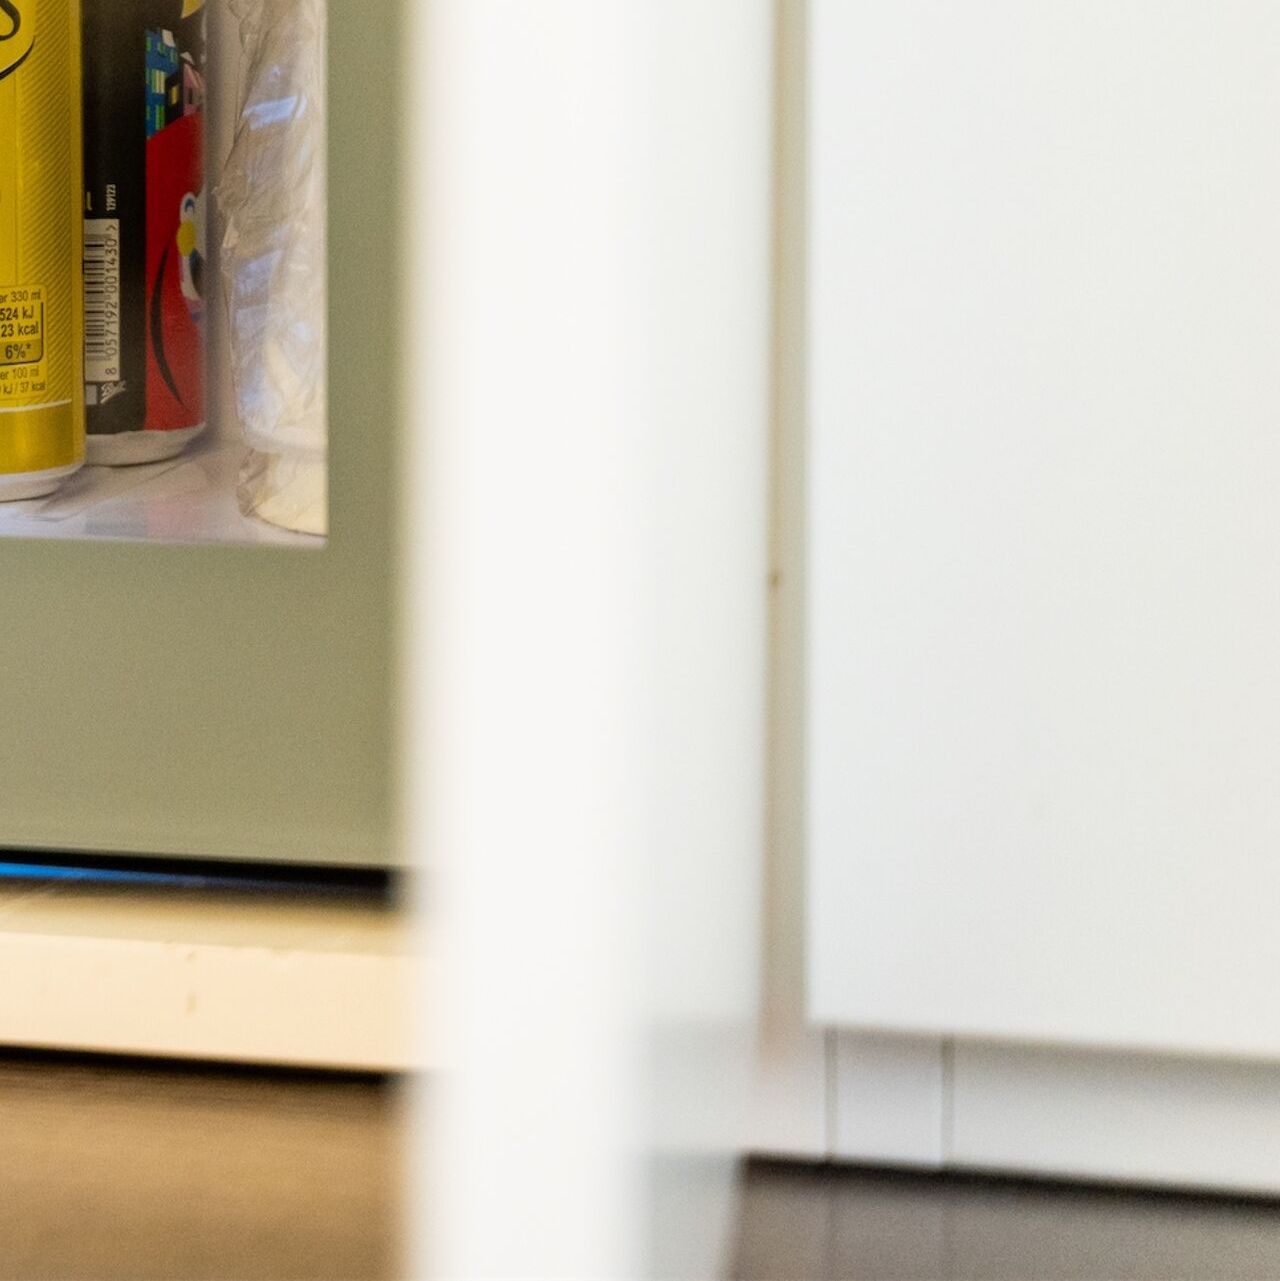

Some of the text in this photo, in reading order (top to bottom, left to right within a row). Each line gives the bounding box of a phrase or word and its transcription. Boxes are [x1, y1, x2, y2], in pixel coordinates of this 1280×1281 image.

[105, 238, 117, 293] 001430
[10, 289, 29, 303] 330
[31, 288, 41, 301] ml
[0, 306, 34, 322] 524 kJ
[17, 320, 39, 336] kcal
[105, 301, 117, 355] 057192
[12, 367, 28, 380] 100
[105, 368, 117, 376] 8
[3, 382, 13, 395] kJ
[20, 381, 30, 393] 37
[31, 380, 46, 393] kcal
